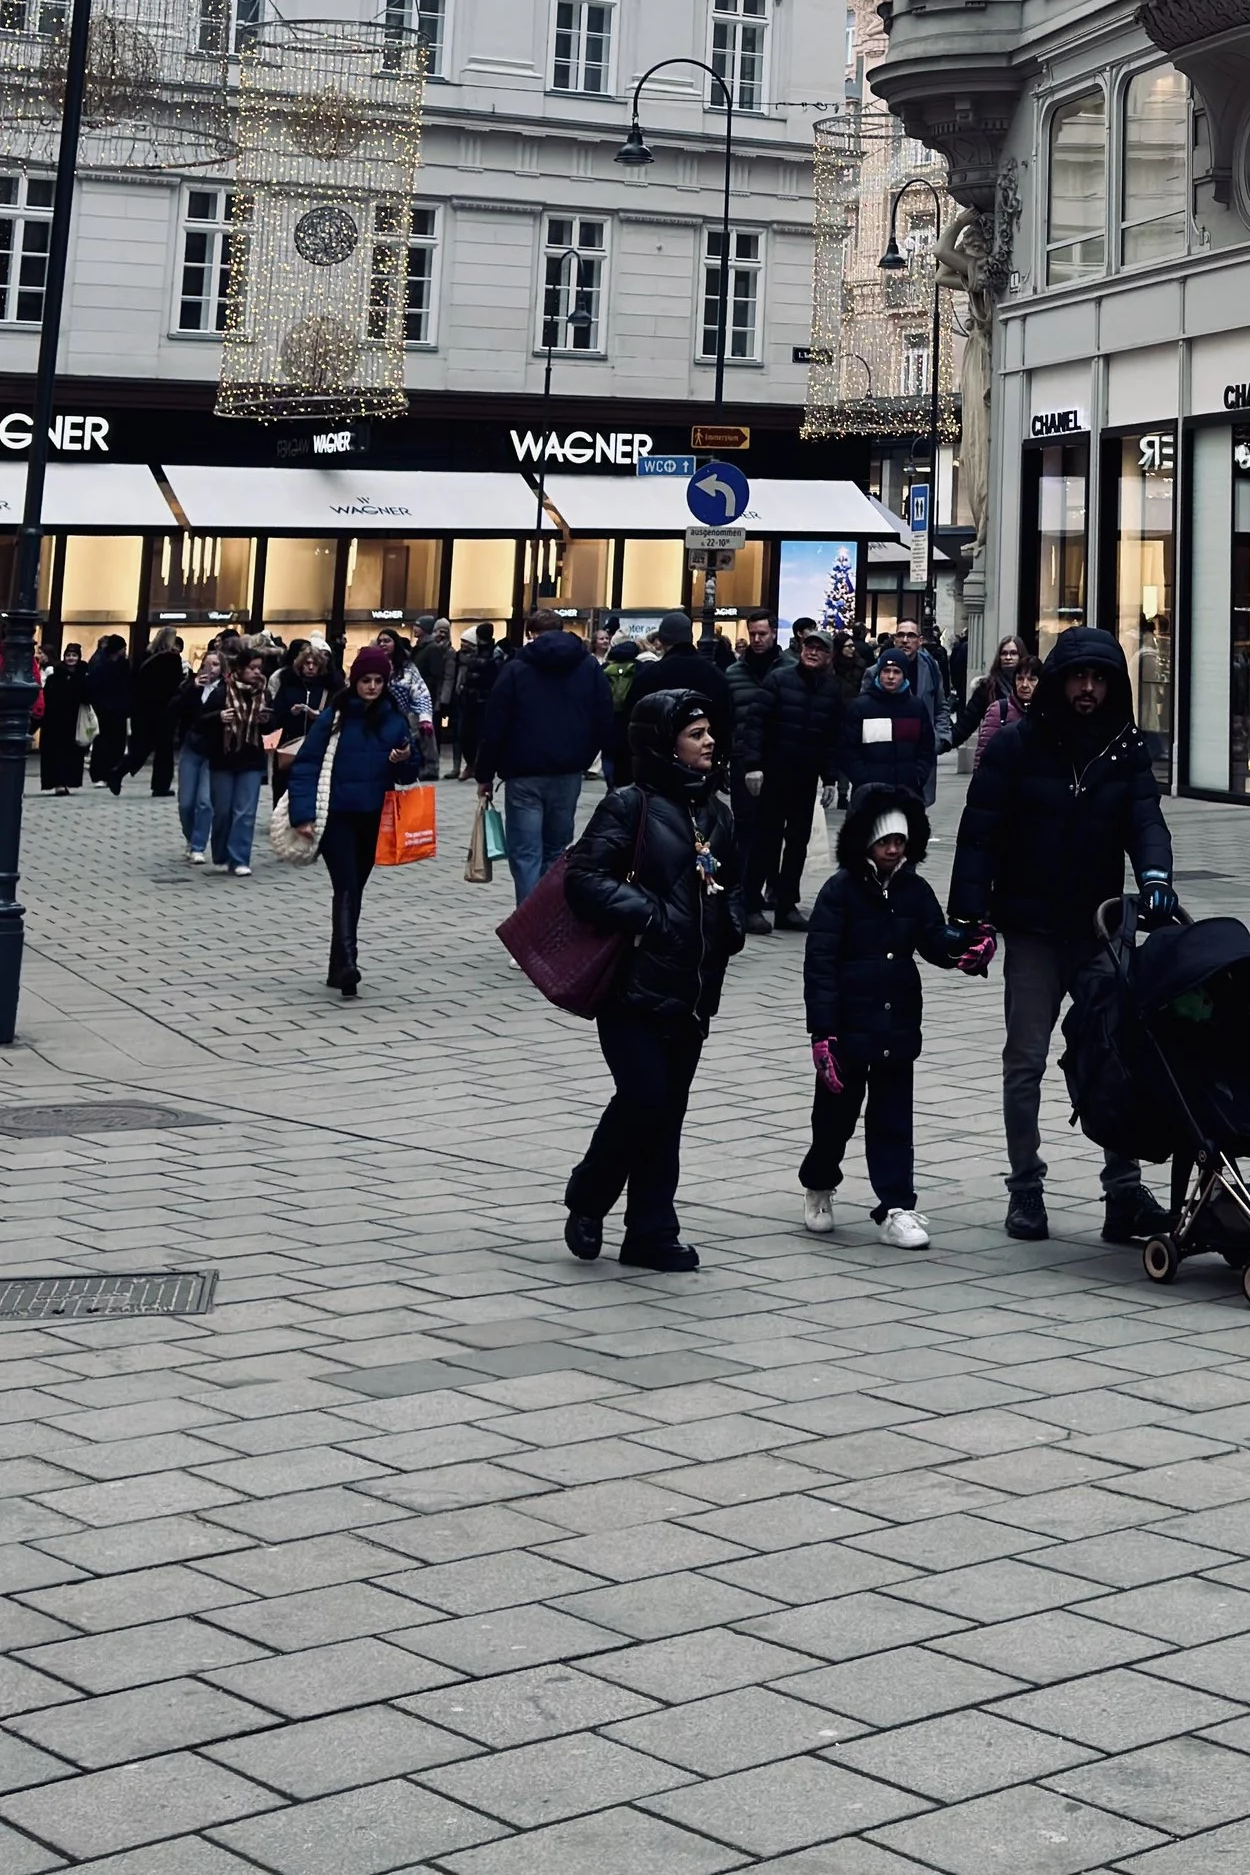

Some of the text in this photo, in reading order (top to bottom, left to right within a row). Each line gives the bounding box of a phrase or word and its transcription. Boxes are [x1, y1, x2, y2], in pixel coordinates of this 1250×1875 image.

[1031, 410, 1082, 437] CHANEL
[313, 431, 351, 454] WAGNER
[510, 429, 654, 465] WAGNER
[644, 460, 665, 473] WC
[329, 504, 412, 516] WAGNER
[690, 528, 742, 538] ausgenommen
